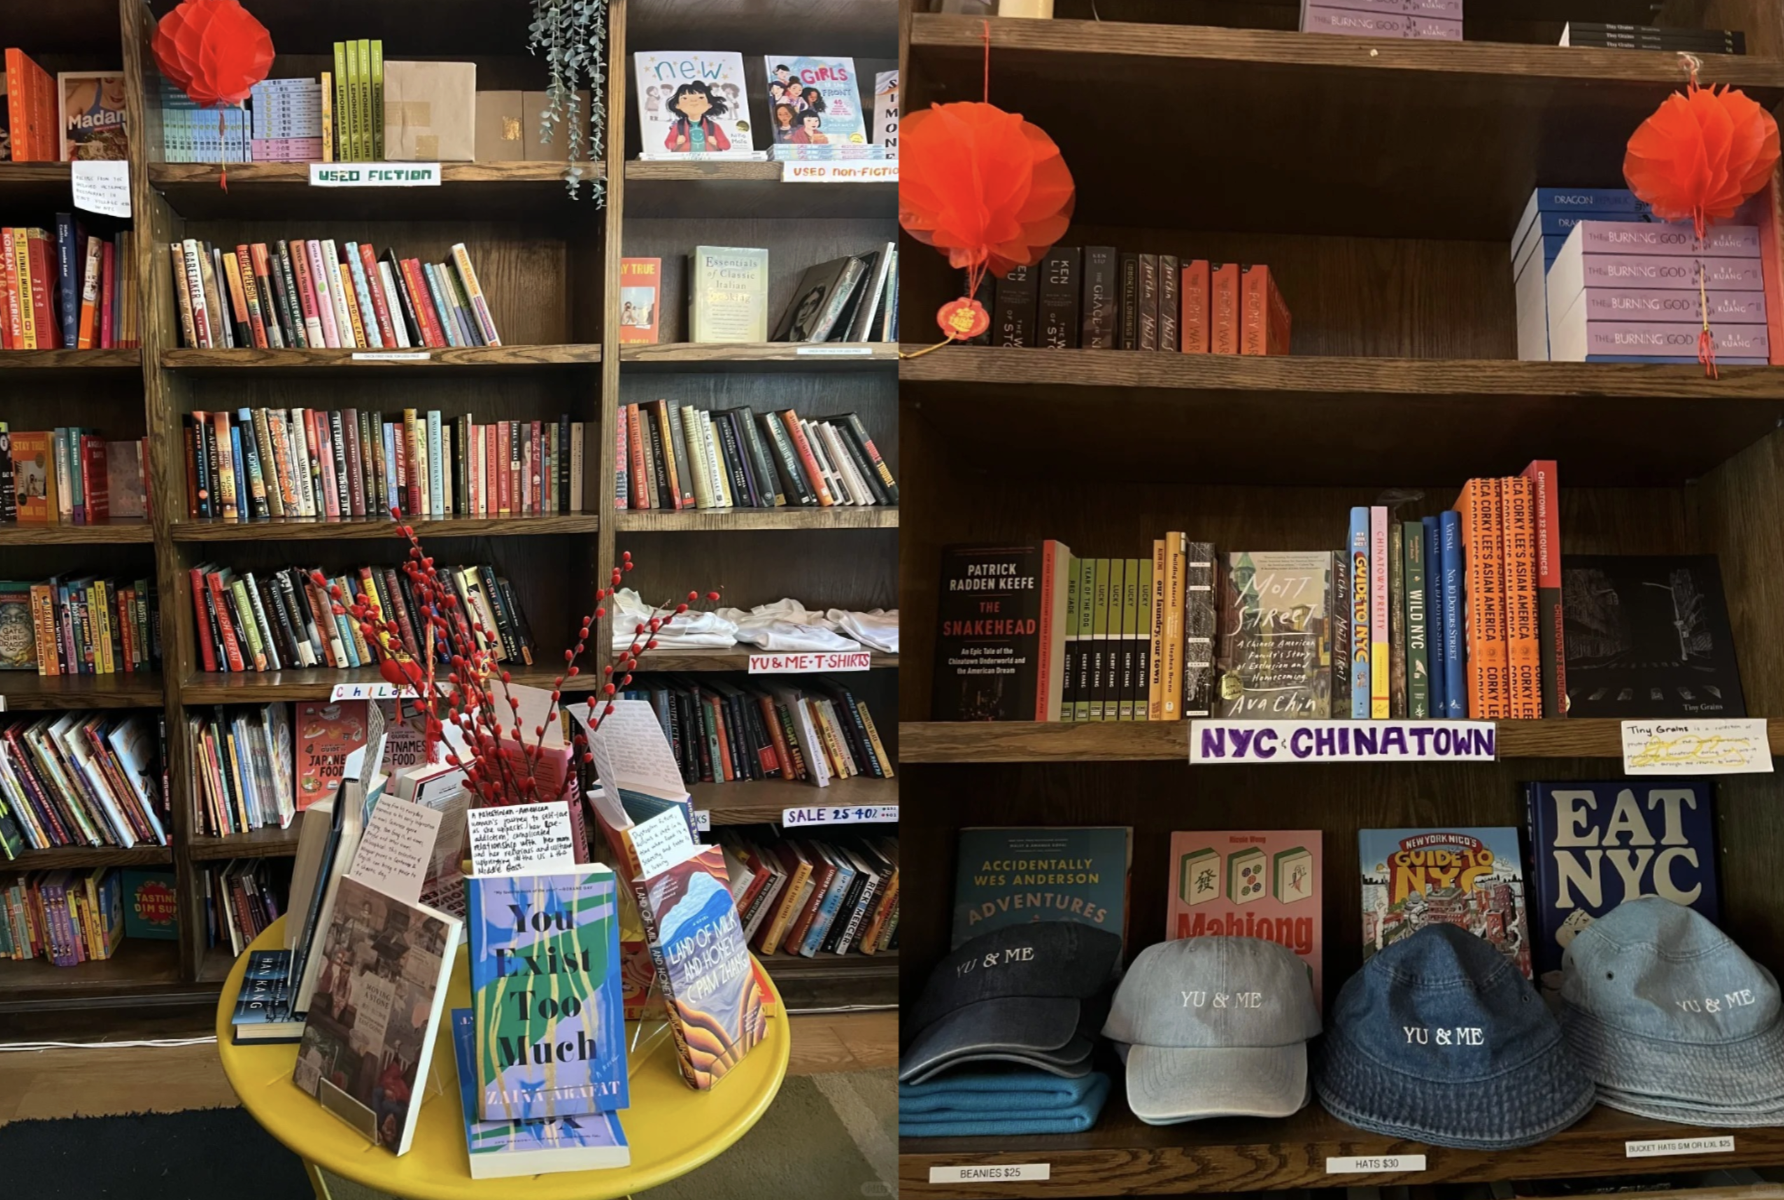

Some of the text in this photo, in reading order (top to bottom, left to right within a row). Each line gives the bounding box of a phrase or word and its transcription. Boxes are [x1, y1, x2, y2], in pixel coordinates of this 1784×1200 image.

[654, 60, 723, 81] new
[800, 67, 848, 84] GIRLS
[319, 170, 432, 182] USED FICTION
[794, 168, 825, 176] USED
[1554, 196, 1593, 205] DRAGON
[1608, 231, 1656, 243] BURNING
[1660, 233, 1686, 244] GOD
[631, 264, 655, 275] TRUE
[706, 257, 757, 267] Essentials
[1050, 261, 1059, 284] LIU
[1060, 261, 1069, 284] KEN
[1608, 264, 1656, 277] BURNING
[1659, 266, 1686, 277] GOD
[185, 252, 201, 299] CARETAKER
[707, 269, 754, 279] of Classic
[716, 280, 746, 289] Italian
[3, 234, 21, 337] KOREAN AMERICAN
[1614, 333, 1663, 345] BURNING
[1666, 334, 1694, 345] GOD
[1537, 471, 1545, 517] CHINATOWN
[1540, 528, 1548, 576] SEQUENCES
[968, 564, 1017, 576] PATRICK
[1481, 498, 1497, 642] CORKY LEE'S ASIAN AMERICA
[1513, 498, 1530, 640] CORKY LEE'S ASIAN AMERICA
[950, 577, 1034, 591] RADDEN KEEFE
[1376, 531, 1385, 630] CHINATOWN PRETTY
[980, 602, 1000, 613] THE
[1354, 556, 1369, 663] GUIDE TO NYC
[216, 596, 241, 662] CHERISH FARRAH
[943, 619, 1036, 636] SNAKEHEAD
[1409, 590, 1424, 650] WILD NYC
[970, 648, 982, 656] Epic
[751, 657, 770, 670] YU
[772, 657, 783, 668] &
[1228, 692, 1316, 717] Ava Chin
[1683, 703, 1723, 712] Tiny Grains
[1627, 726, 1652, 736] Tiny
[1656, 725, 1689, 734] Grains
[1201, 727, 1494, 758] NYC CHINATOWN
[392, 752, 416, 766] FOOD
[788, 808, 826, 823] SALE
[1551, 788, 1697, 847] EAT
[1229, 835, 1267, 845] Nicole Wong
[1406, 836, 1426, 848] NEW
[1425, 834, 1448, 846] YORK
[981, 858, 1094, 872] ACCIDENTALLY
[1394, 848, 1494, 868] GUIDE TO
[974, 872, 1100, 887] WES ANDERSON
[1395, 866, 1494, 905] NYC
[1552, 847, 1702, 908] NYC
[634, 886, 650, 922] LAND OF
[842, 881, 876, 945] RICK MERCER
[967, 891, 1108, 927] ADVENTURES
[507, 903, 575, 934] You
[667, 911, 739, 965] LAND OF MILK
[495, 944, 593, 979] Exist
[683, 935, 736, 981] AND HONEY
[956, 946, 1035, 978] YU & ME
[250, 957, 274, 1010] HAN KANG
[652, 949, 673, 997] AND HONEY
[694, 975, 719, 1000] PAM
[718, 954, 748, 986] ZHANG
[509, 989, 583, 1022] Too
[1180, 991, 1262, 1010] YU & ME
[1705, 997, 1722, 1013] &
[1725, 989, 1756, 1009] ME
[1403, 1025, 1485, 1046] YU & ME
[497, 1029, 598, 1068] Much
[486, 1080, 621, 1105] ZAINA ARAFAT
[1628, 1144, 1655, 1152] BUCKET
[1658, 1143, 1676, 1151] HATS
[960, 1168, 1021, 1178] BEANIES $25
[1356, 1158, 1399, 1169] HATS $30
